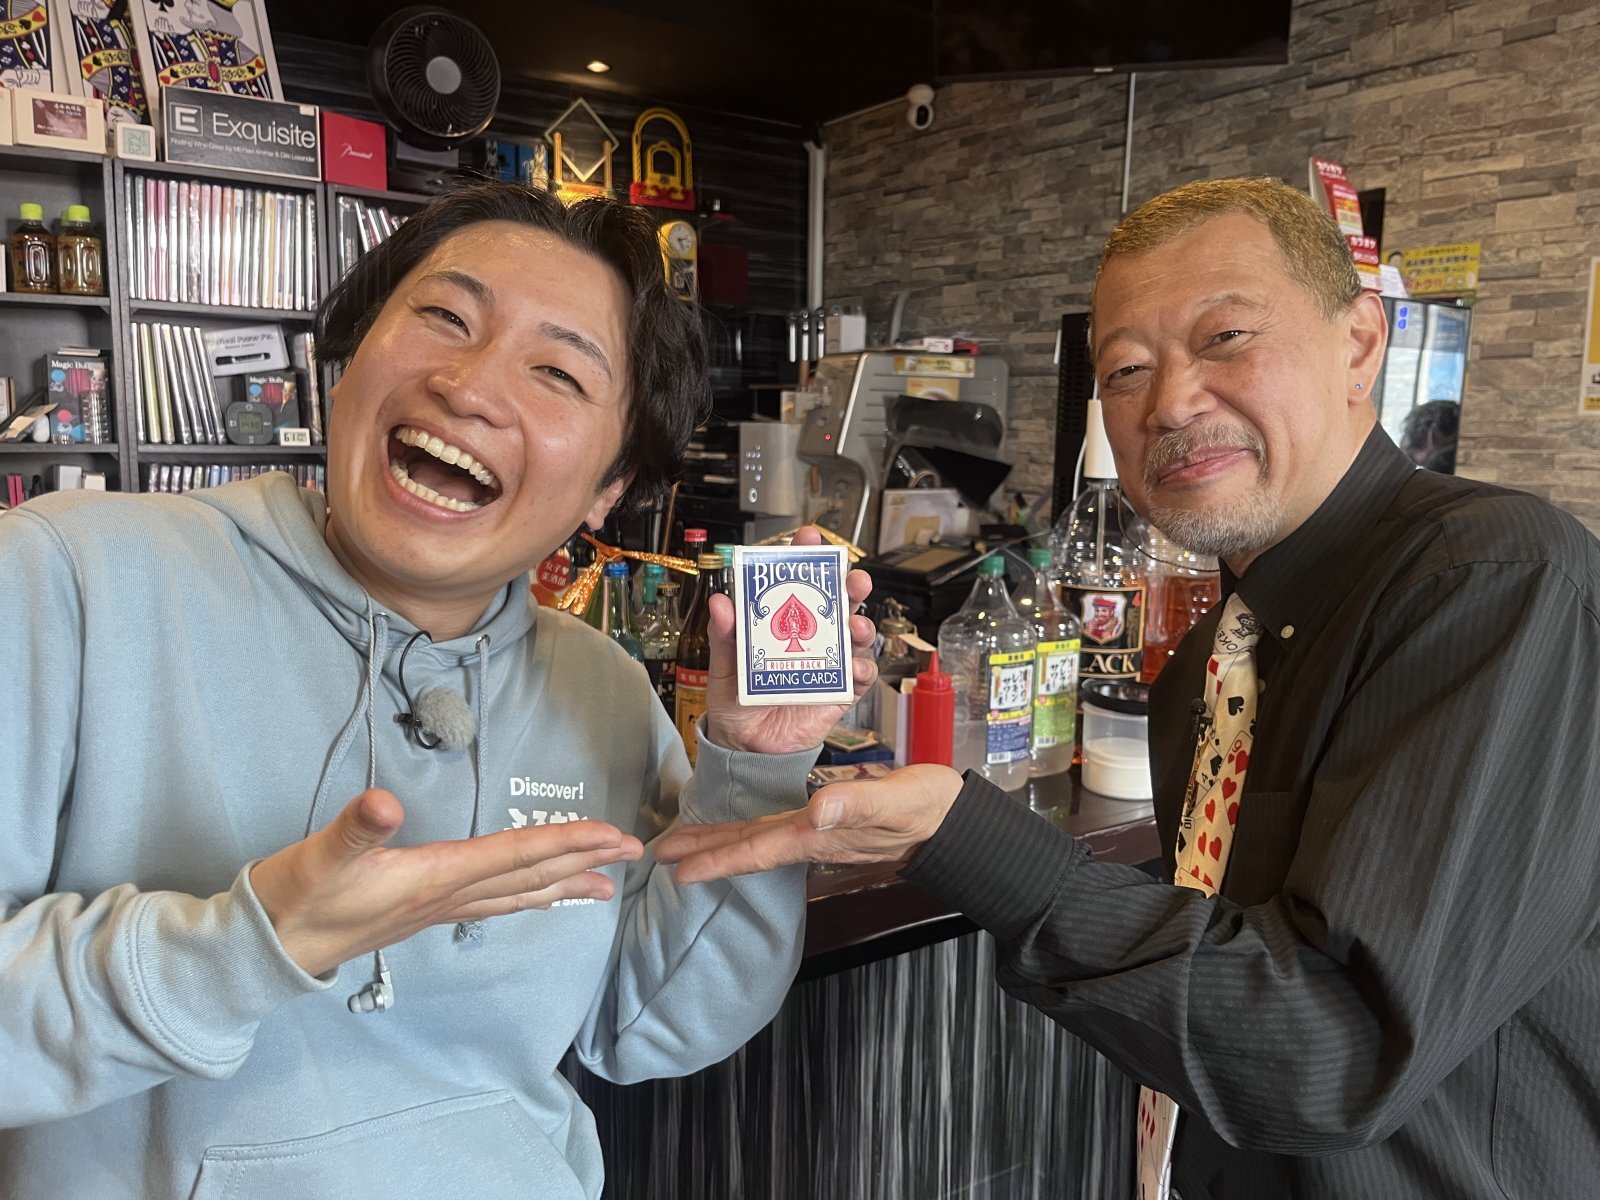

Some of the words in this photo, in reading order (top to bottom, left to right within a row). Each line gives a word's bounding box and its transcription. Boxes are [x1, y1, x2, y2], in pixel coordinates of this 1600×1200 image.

[212, 112, 316, 149] Exquisite
[51, 360, 73, 370] Magic
[249, 376, 267, 384] Magic
[753, 562, 833, 600] BICYCLE
[770, 662, 795, 670] RIDER
[800, 661, 822, 669] BACK
[755, 674, 800, 686] PLAYING
[802, 672, 838, 684] CARDS
[509, 777, 584, 800] Discover!
